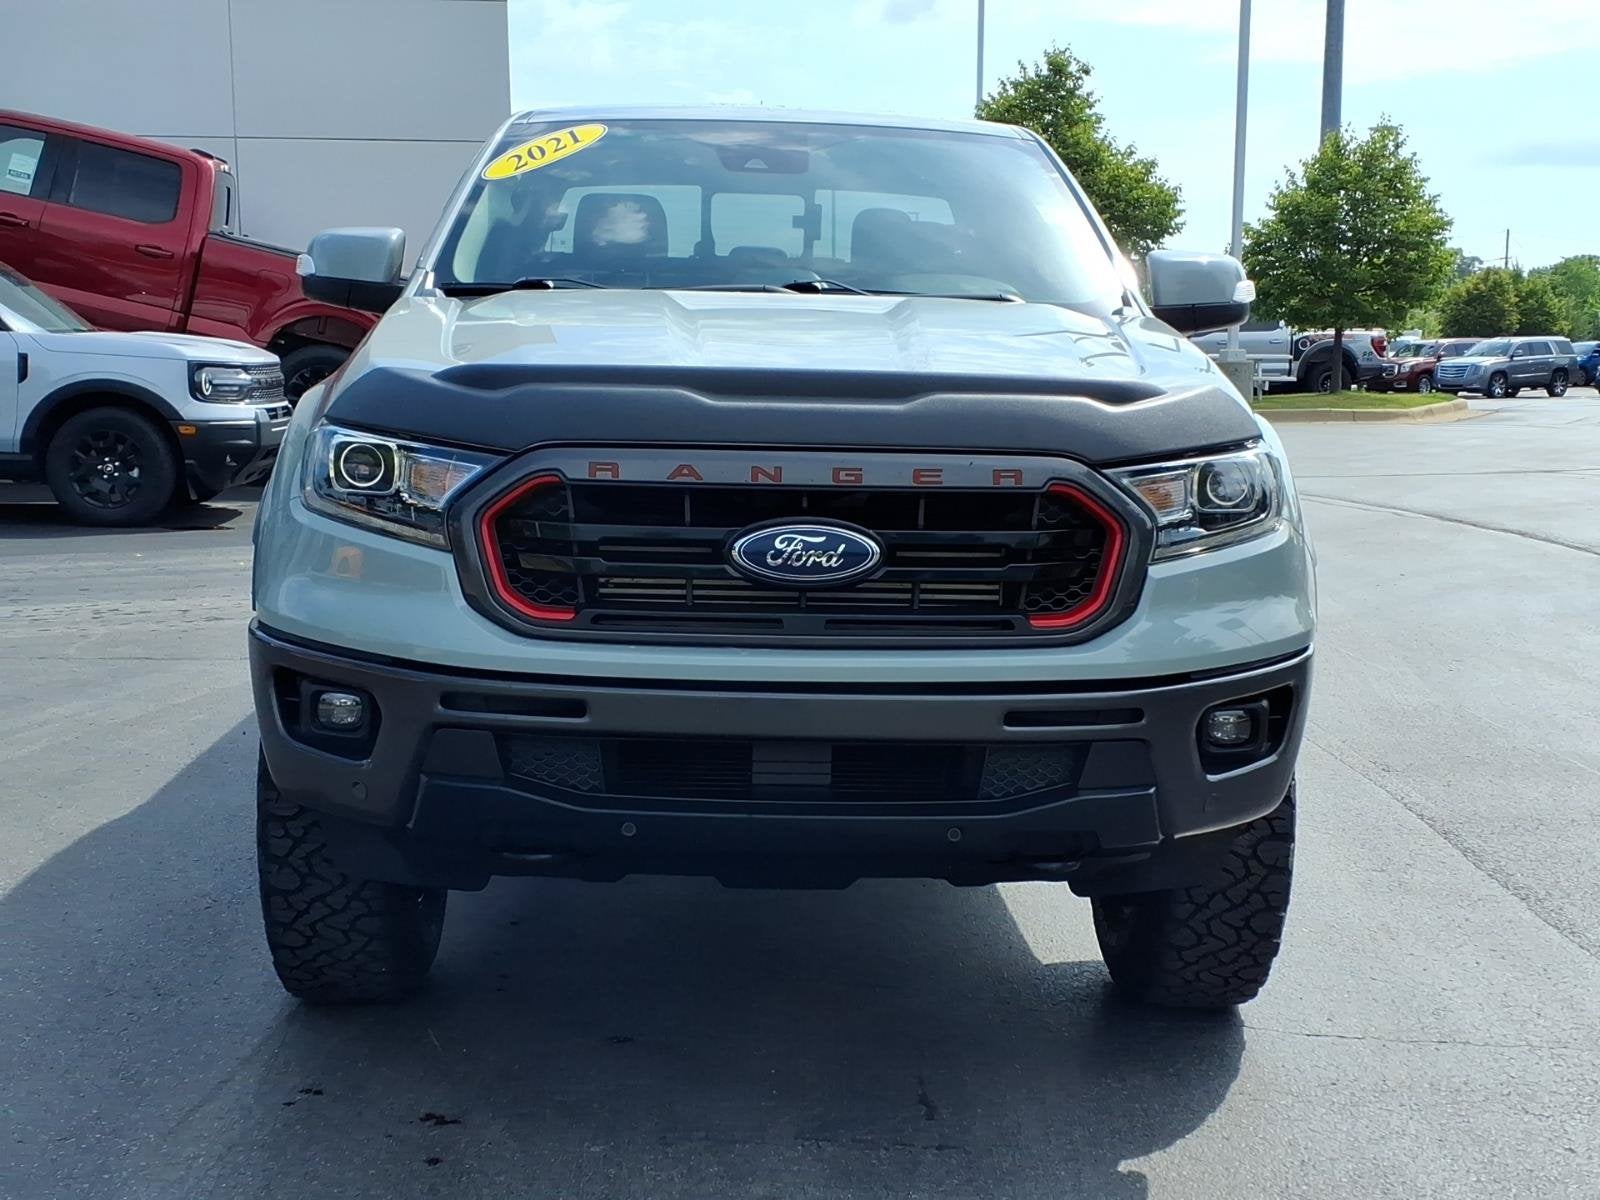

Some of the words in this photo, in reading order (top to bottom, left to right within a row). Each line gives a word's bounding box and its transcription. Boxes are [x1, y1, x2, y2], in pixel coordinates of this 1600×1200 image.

[506, 129, 584, 171] 2021
[588, 461, 1023, 486] RANGER
[766, 534, 846, 567] Ford
